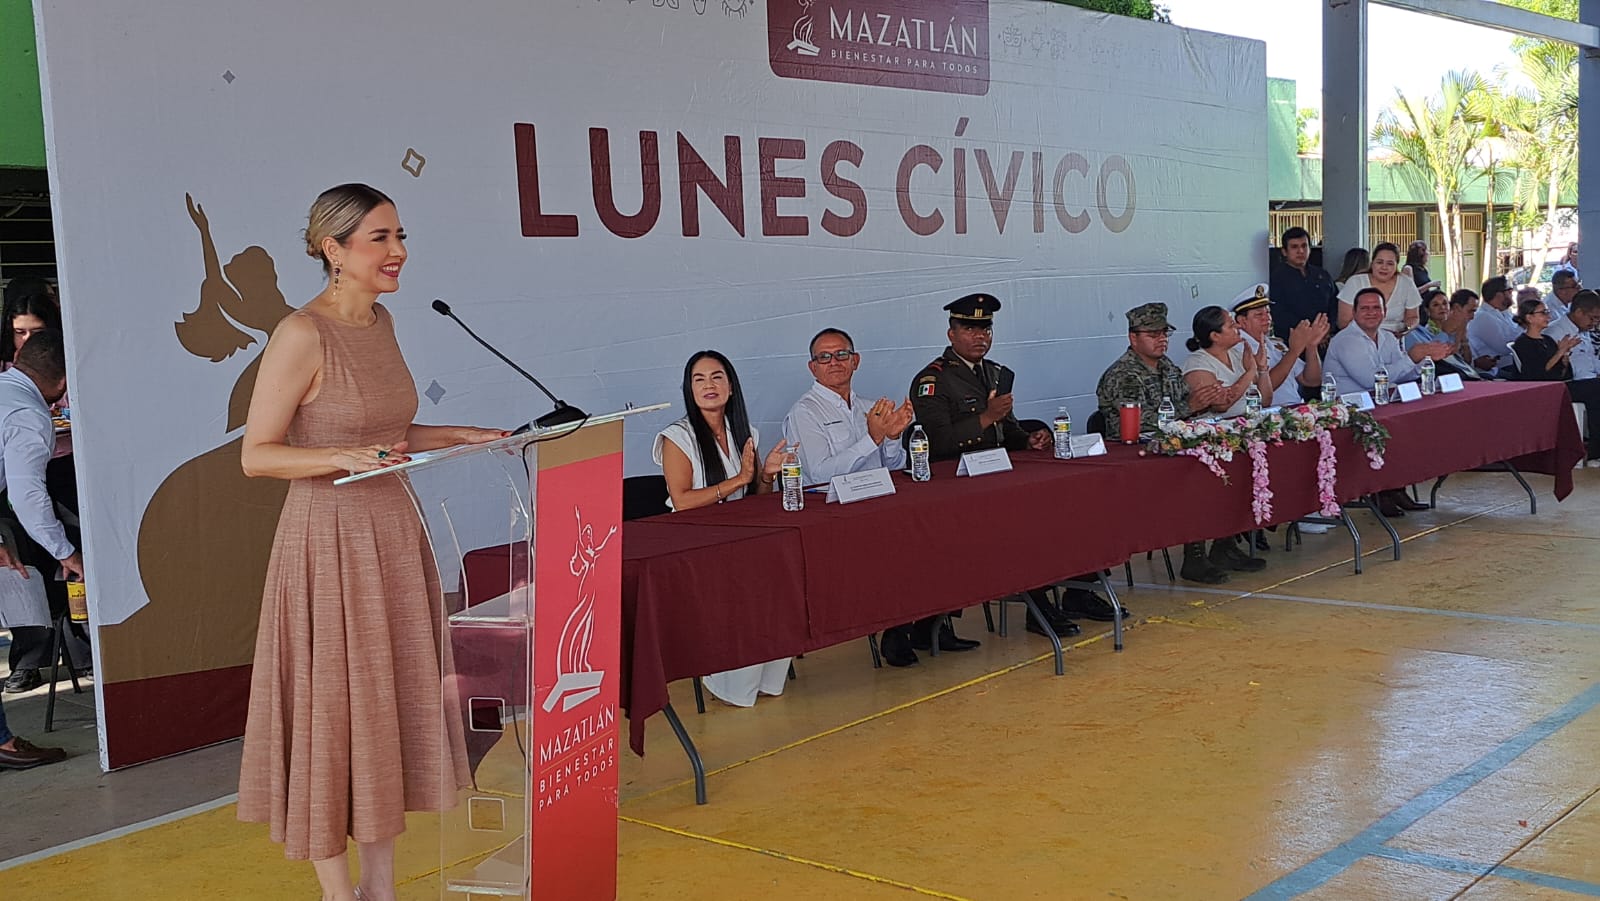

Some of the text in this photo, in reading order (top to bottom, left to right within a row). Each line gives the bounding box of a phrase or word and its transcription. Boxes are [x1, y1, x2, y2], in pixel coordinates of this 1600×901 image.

[829, 6, 978, 57] MAZATLÁN
[831, 49, 978, 74] BIENESTAR PARA TODOS
[513, 116, 1137, 239] LUNES CÍVICO
[540, 703, 615, 766] MAZATLÁN
[539, 755, 614, 812] PARA TODOS
[540, 738, 614, 793] BIENESTAR
